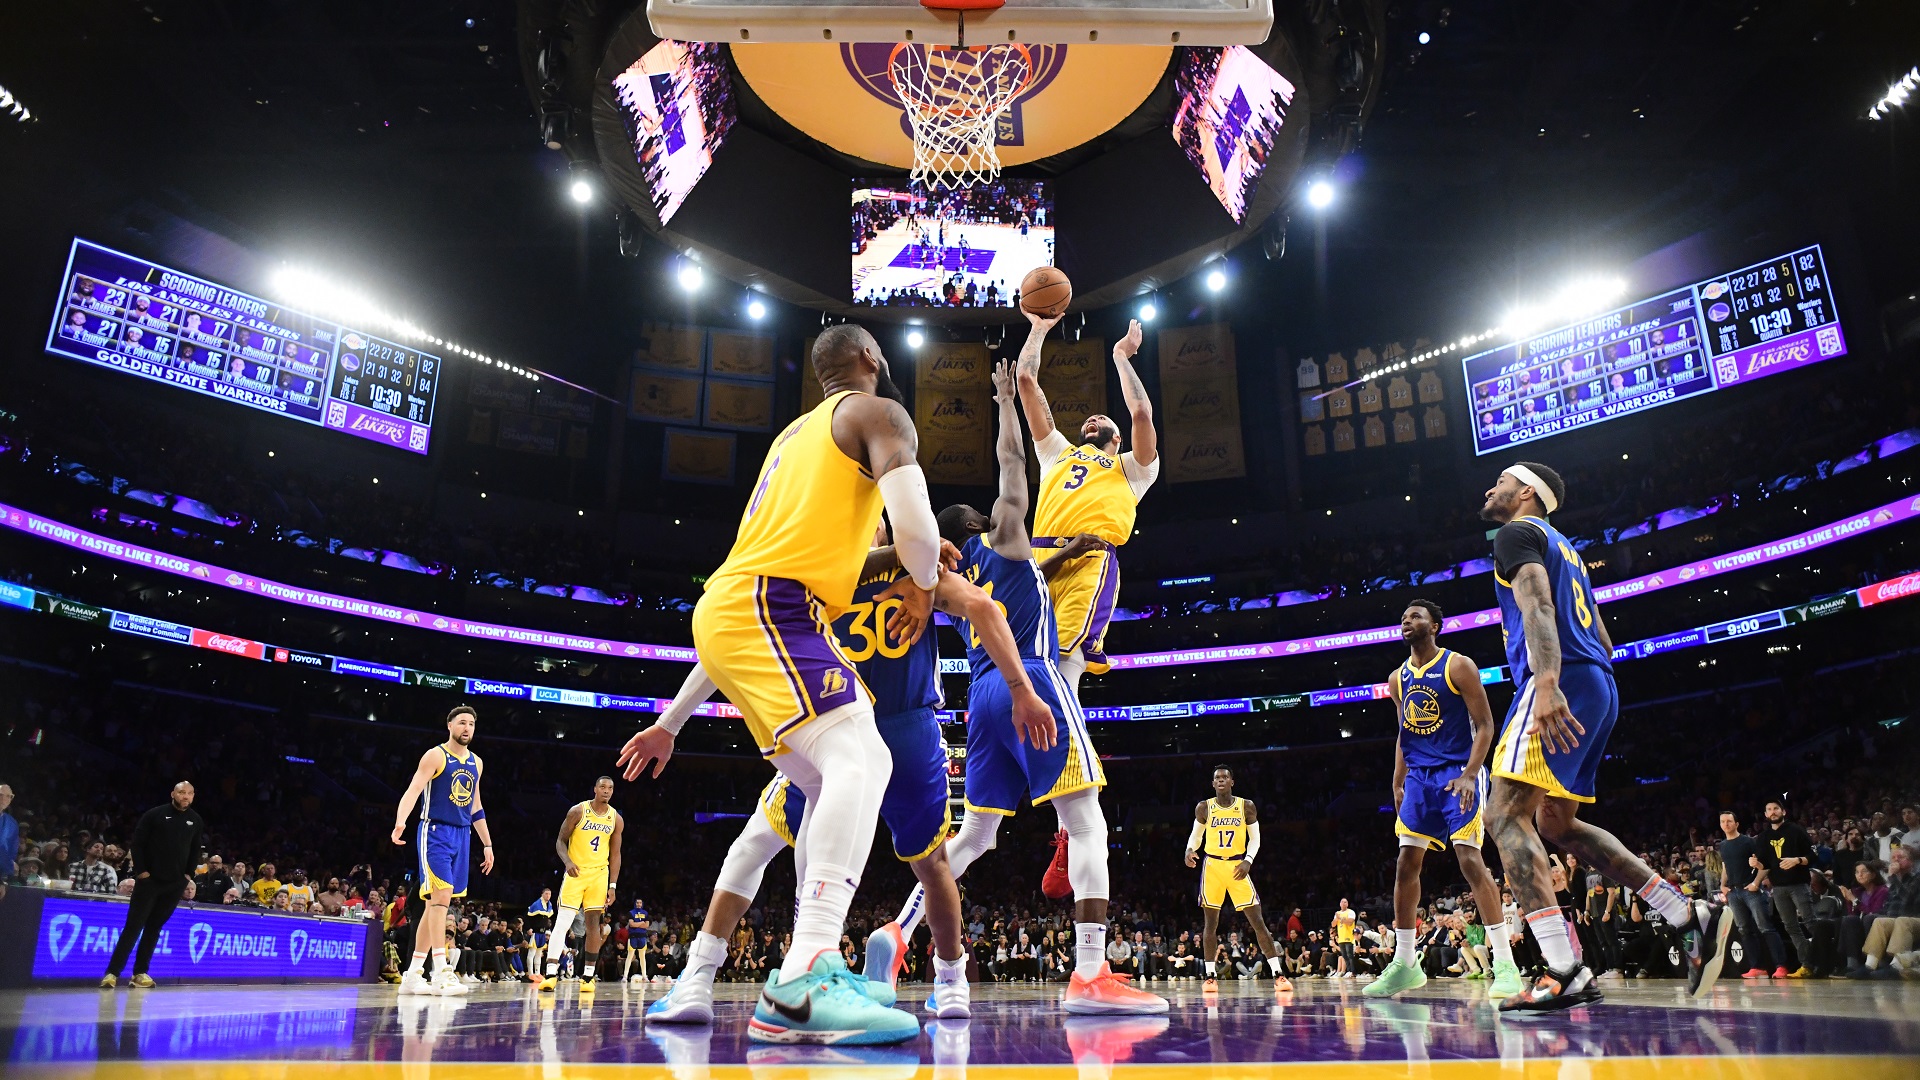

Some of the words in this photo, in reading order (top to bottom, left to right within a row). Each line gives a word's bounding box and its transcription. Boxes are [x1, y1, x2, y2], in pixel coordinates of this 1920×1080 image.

[1732, 278, 1746, 293] 22
[1747, 273, 1759, 288] 27
[1762, 267, 1776, 282] 28
[1782, 263, 1789, 276] 5
[1799, 254, 1814, 271] 82
[104, 289, 125, 306] 23
[160, 273, 218, 303] SCORING
[217, 291, 267, 319] LEADERS
[1737, 298, 1748, 313] 21
[1751, 293, 1763, 308] 31
[1767, 287, 1781, 302] 32
[1787, 283, 1794, 296] 0
[1804, 275, 1820, 292] 84
[89, 300, 116, 316] JAMES
[115, 277, 151, 294] LOS
[155, 289, 233, 322] ANGELES
[235, 315, 300, 340] LAKERS
[1673, 299, 1690, 312] GAME
[160, 306, 178, 322] 21
[1749, 308, 1791, 335] 10:30
[100, 320, 117, 338] 21
[147, 318, 168, 332] DAVIS
[214, 322, 228, 337] 17
[1678, 324, 1686, 339] 4
[82, 332, 108, 347] CURRY
[316, 330, 332, 341] GAME
[1529, 330, 1574, 355] SCORING
[1576, 314, 1622, 340] LEADERS
[156, 336, 170, 353] 15
[262, 337, 276, 352] 10
[1178, 339, 1218, 356] LAKERS
[1500, 361, 1526, 375] LOS
[1530, 339, 1594, 365] ANGELES
[1598, 318, 1660, 344] LAKERS
[1628, 338, 1641, 354] 10
[133, 345, 162, 363] PAYTON
[206, 352, 222, 368] 15
[310, 352, 320, 367] 4
[369, 343, 381, 357] 22
[381, 347, 392, 360] 27
[394, 351, 405, 365] 28
[408, 356, 414, 368] 5
[423, 360, 434, 374] 82
[1047, 353, 1090, 369] LAKERS
[1584, 352, 1595, 367] 17
[1684, 354, 1693, 369] 8
[1744, 344, 1814, 375] LAKERS
[188, 361, 219, 378] WIGGINS
[932, 356, 977, 371] LAKERS
[1330, 365, 1342, 375] 22
[97, 351, 162, 376] GOLDEN
[166, 370, 208, 389] STATE
[213, 382, 287, 411] WARRIORS
[256, 366, 270, 383] 10
[366, 361, 376, 375] 21
[378, 365, 387, 379] 31
[391, 369, 402, 383] 32
[406, 375, 411, 386] 0
[419, 379, 431, 393] 84
[1540, 366, 1552, 381] 21
[1634, 367, 1648, 383] 10
[1673, 371, 1694, 383] GREEN
[304, 381, 314, 395] 8
[1497, 378, 1511, 394] 23
[1588, 381, 1601, 396] 15
[290, 391, 310, 405] GREEN
[369, 384, 401, 408] 10:30
[1334, 399, 1347, 408] 52
[1364, 395, 1377, 404] 33
[1394, 391, 1407, 400] 32
[1544, 393, 1557, 409] 15
[1577, 396, 1604, 410] WIGGINS
[1050, 400, 1090, 414] LAKERS
[1503, 406, 1515, 422] 21
[1509, 418, 1561, 442] GOLDEN
[1563, 410, 1599, 427] STATE
[1603, 388, 1675, 416] WARRIORS
[349, 414, 406, 443] LAKERS
[932, 451, 976, 466] LAKERS
[1181, 444, 1229, 462] LAKERS
[1064, 464, 1088, 490] 3
[750, 455, 779, 517] 6
[29, 518, 79, 542] VICTORY
[81, 535, 123, 555] TASTES
[125, 547, 151, 563] LIKE
[155, 555, 190, 572] TACOS
[1713, 550, 1762, 570] VICTORY
[1764, 539, 1806, 556] TASTES
[1807, 529, 1832, 545] LIKE
[1834, 517, 1870, 536] TACOS
[1613, 581, 1644, 596] TACOS
[261, 583, 305, 601] VICTORY
[307, 594, 345, 609] TASTES
[346, 601, 369, 613] LIKE
[371, 606, 402, 619] TACOS
[129, 613, 154, 626] Medical
[155, 619, 177, 630] Center
[1727, 619, 1759, 635] 9:00
[130, 622, 151, 633] Stroke
[153, 627, 187, 639] Committee
[465, 624, 507, 637] VICTORY
[508, 630, 542, 642] TASTES
[544, 636, 565, 646] LIKE
[567, 639, 594, 649] TACOS
[840, 598, 911, 662] 30
[1315, 635, 1354, 648] VICTORY
[1356, 630, 1390, 642] TASTES
[1656, 632, 1698, 649] crypto.com
[290, 654, 322, 665] TOYOTA
[655, 649, 694, 659] VICTORY
[1133, 656, 1170, 665] VICTORY
[1172, 653, 1205, 661] TASTES
[1228, 648, 1256, 656] TACOS
[338, 662, 370, 673] AMERICAN
[371, 668, 399, 677] EXPRESS
[474, 681, 522, 695] Spectrum
[1314, 692, 1339, 702] Michelob
[1344, 689, 1370, 698] ULTRA
[1422, 684, 1439, 697] STATE
[539, 690, 558, 699] UCLA
[563, 693, 591, 703] Health
[611, 699, 649, 708] crypto.com
[1207, 702, 1244, 712] crypto.com
[1422, 700, 1437, 711] 22
[1089, 710, 1127, 719] DELTA
[1403, 719, 1444, 735] WARRIORS
[449, 794, 473, 807] WARRIORS
[582, 820, 612, 834] LAKERS
[1210, 816, 1242, 828] LAKERS
[590, 836, 600, 851] 4
[1218, 830, 1235, 848] 17
[1504, 916, 1513, 925] 32
[213, 933, 278, 958] FANDUEL
[307, 938, 357, 960] FANDUEL
